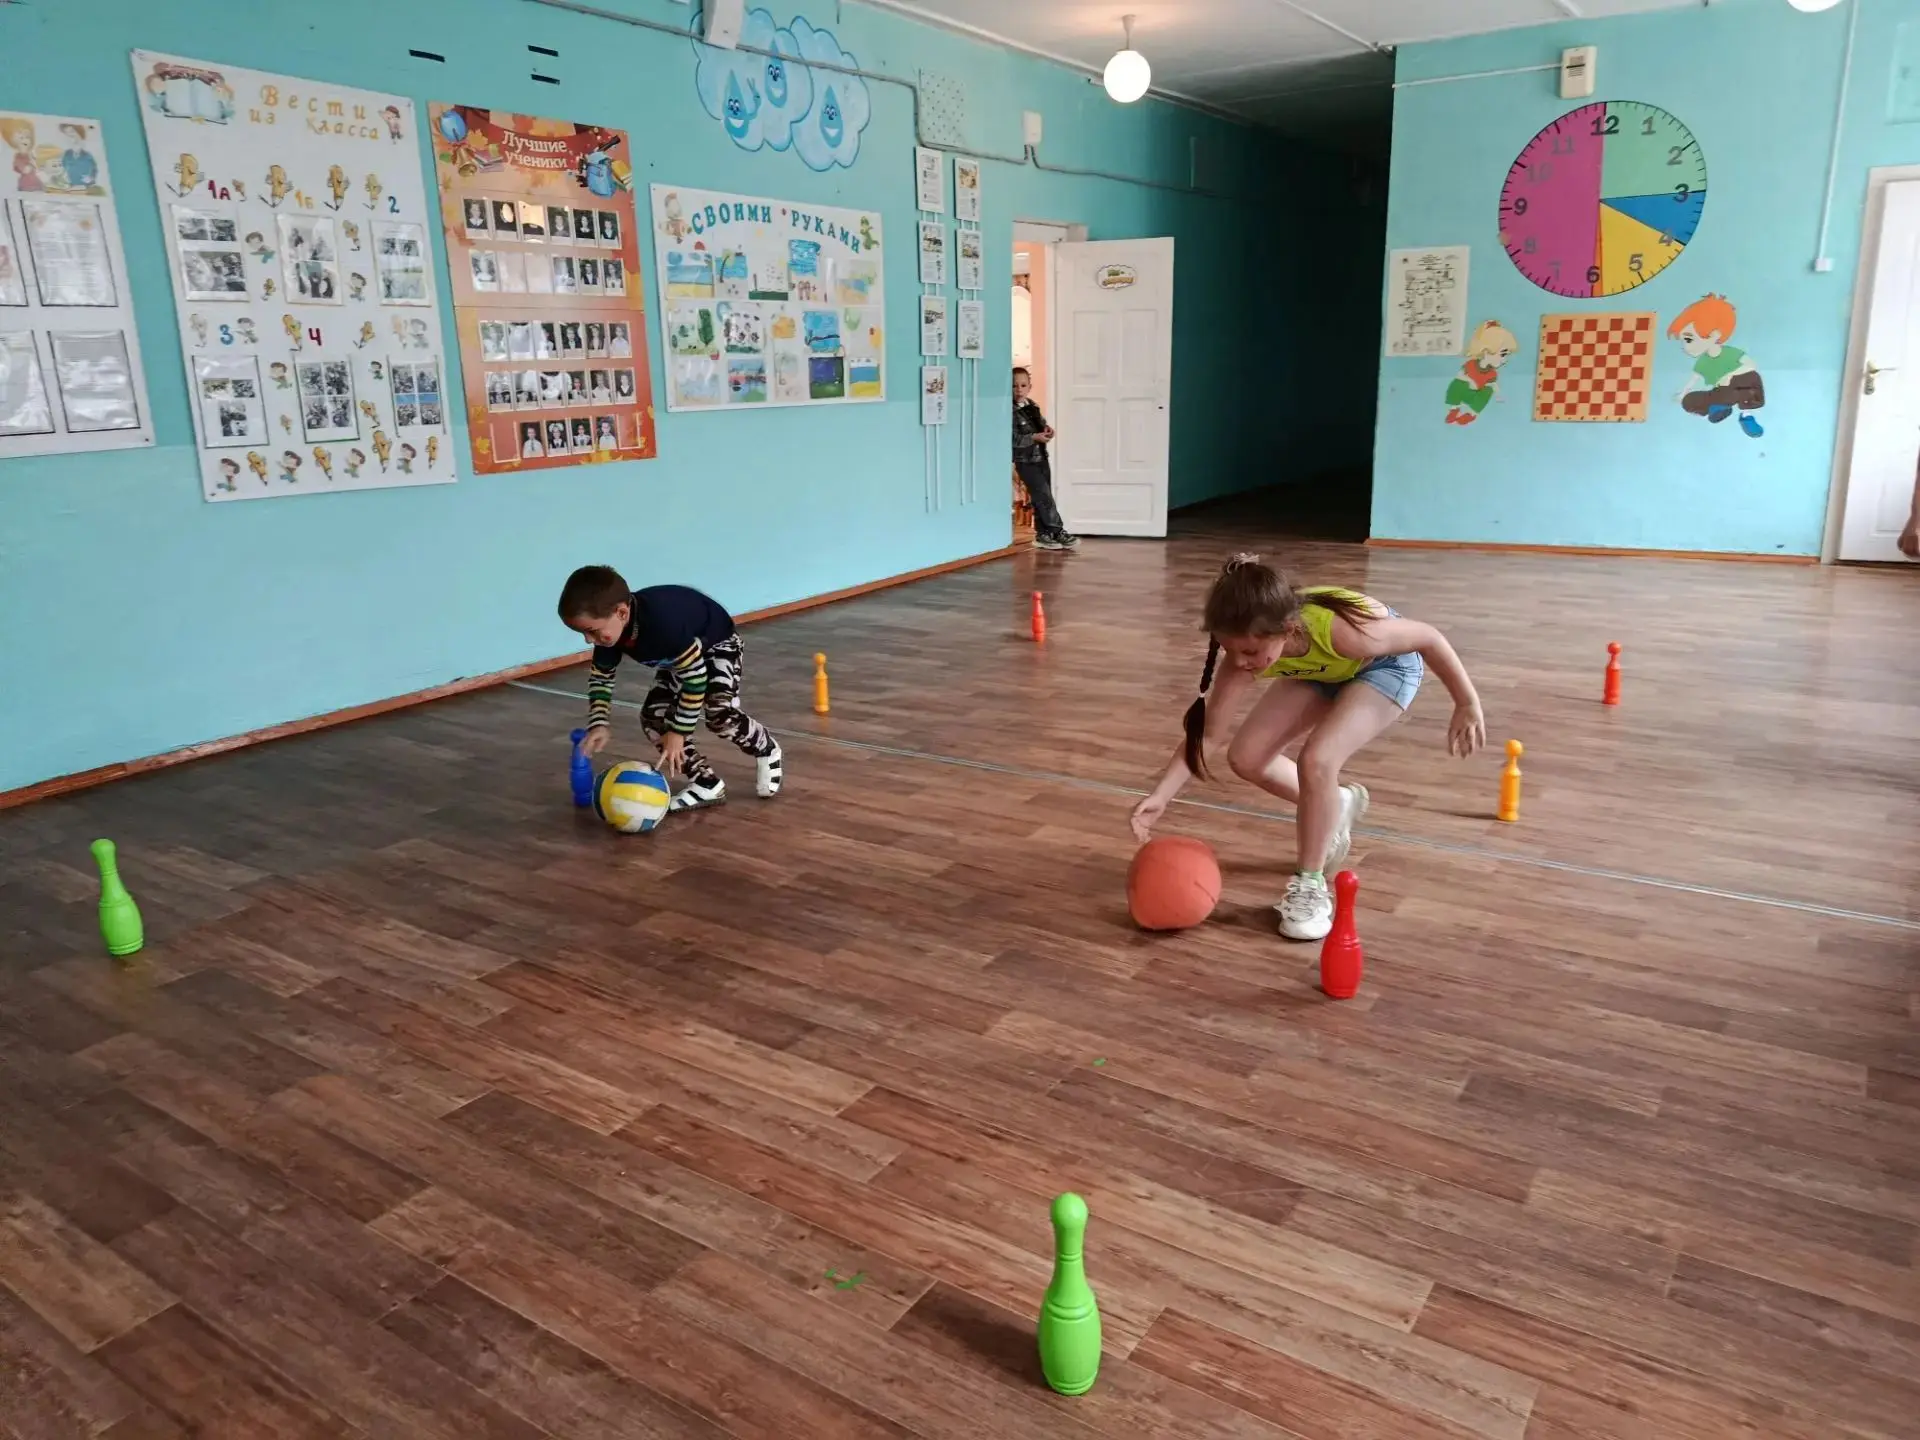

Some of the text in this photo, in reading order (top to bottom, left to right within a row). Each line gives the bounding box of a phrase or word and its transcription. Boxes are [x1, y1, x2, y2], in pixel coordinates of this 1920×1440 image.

[260, 84, 366, 121] Вести
[249, 108, 276, 125] из
[1590, 115, 1620, 136] 12
[1641, 116, 1656, 135] 1
[502, 130, 568, 153] Лучшие
[1551, 136, 1575, 155] 11
[504, 150, 568, 169] ученики
[1667, 146, 1683, 166] 2
[1526, 163, 1553, 183] 10
[1673, 183, 1689, 203] 3
[387, 196, 400, 213] 2
[1514, 198, 1528, 216] 9
[691, 202, 861, 254] СВОИМИ РУКАМИ
[1658, 228, 1673, 246] 4
[1523, 237, 1538, 254] 8
[1549, 262, 1562, 280] 7
[1629, 253, 1643, 272] 5
[1586, 266, 1600, 284] 6
[219, 324, 234, 345] 3
[308, 328, 322, 346] 4
